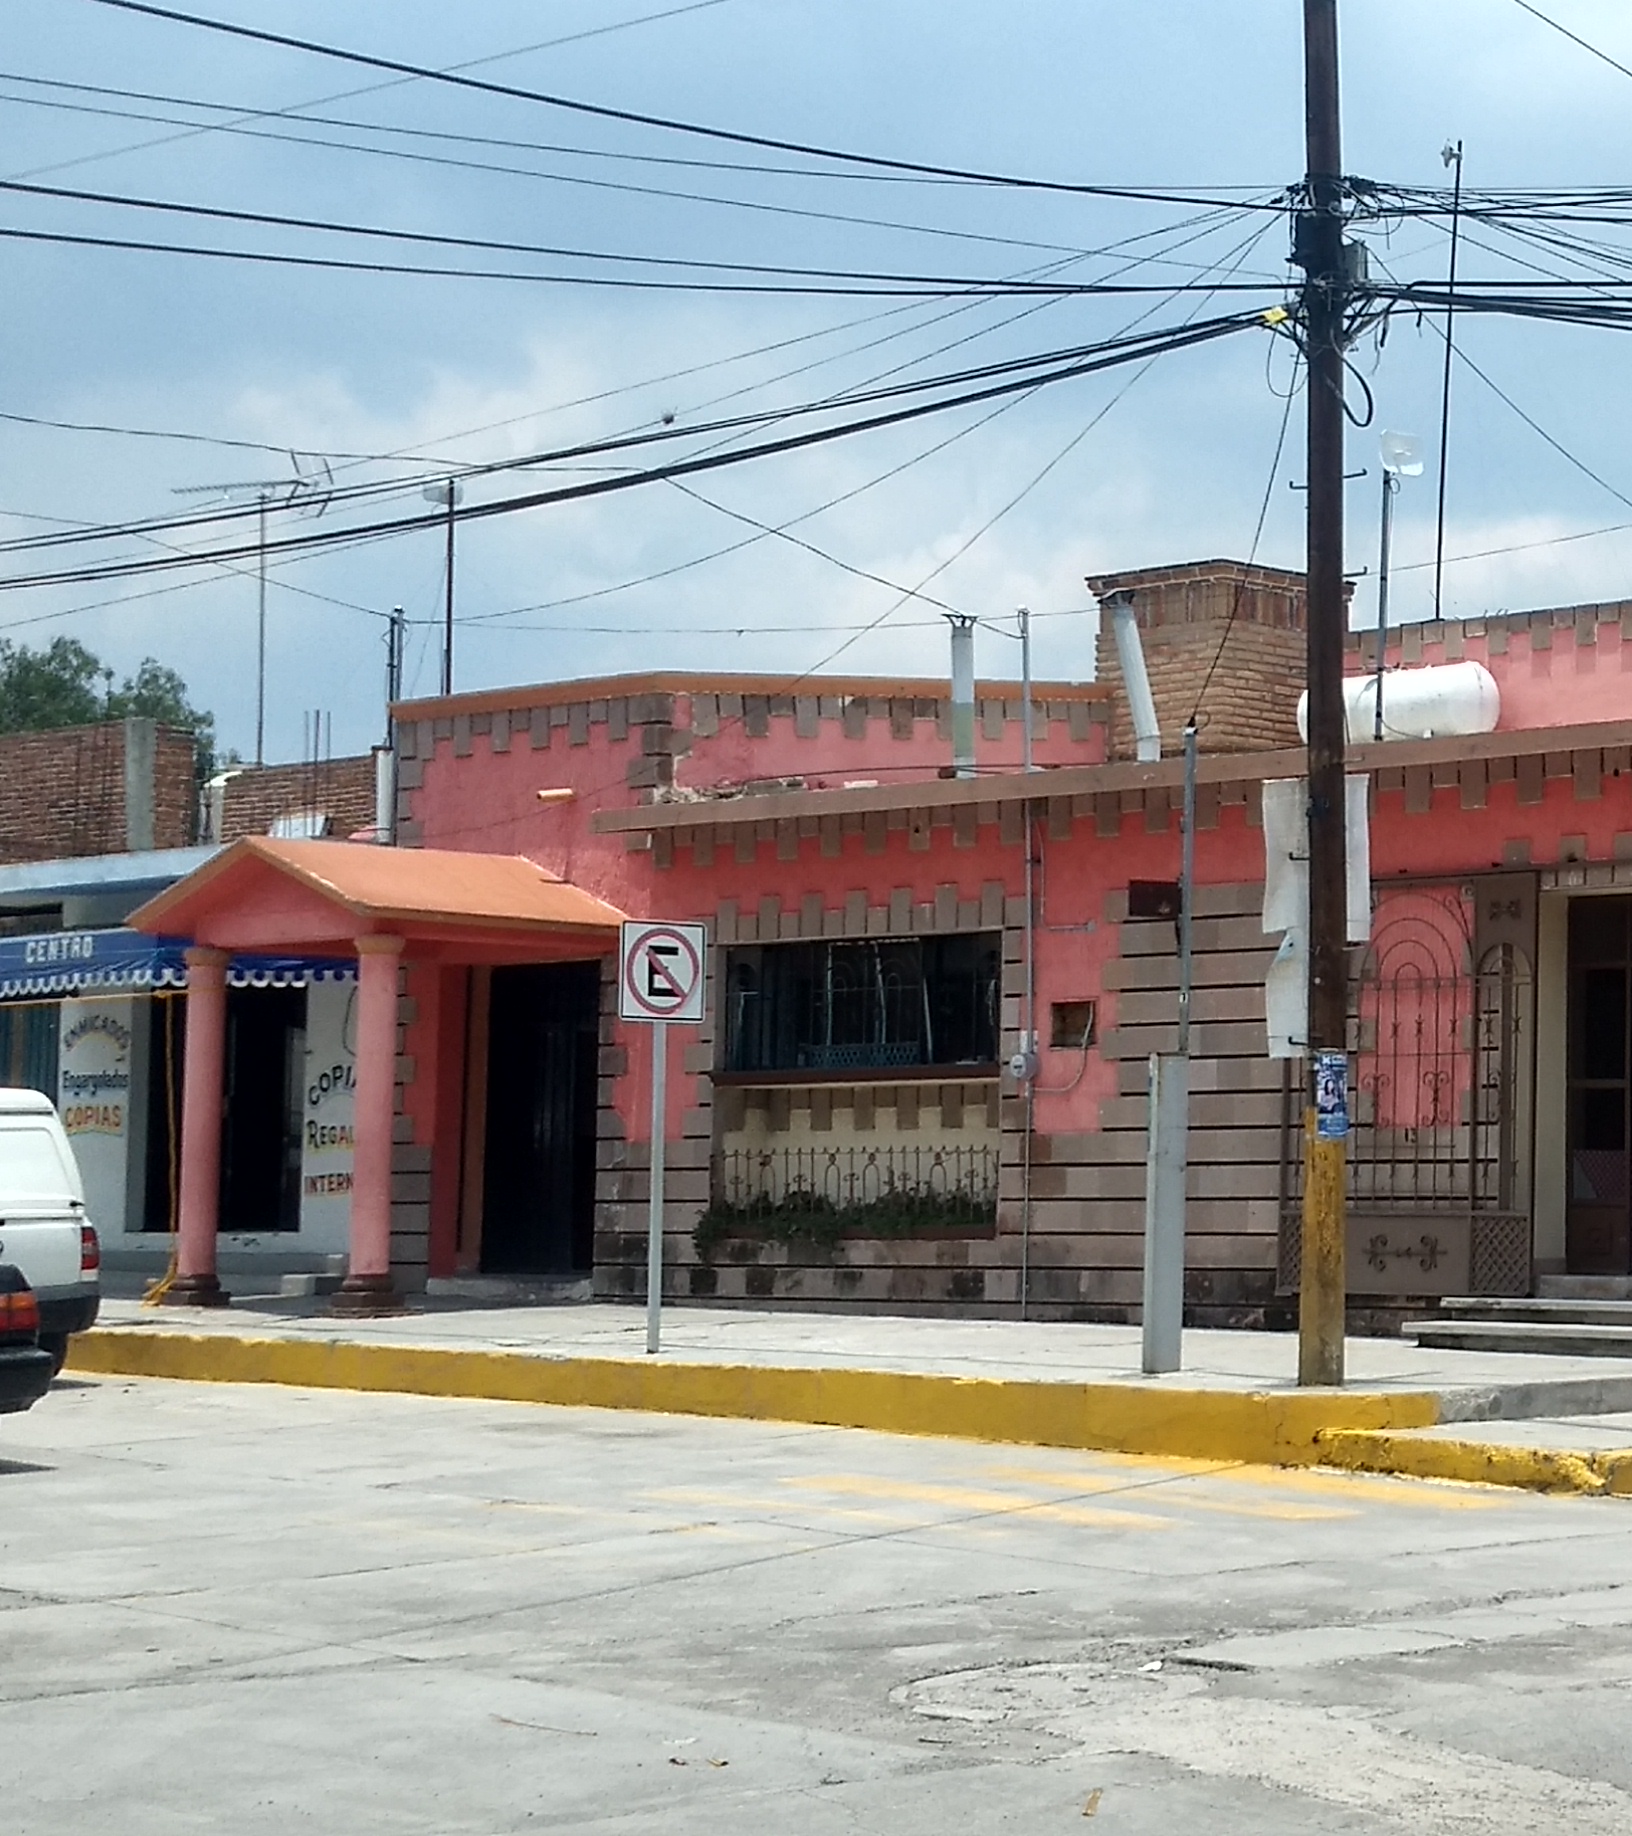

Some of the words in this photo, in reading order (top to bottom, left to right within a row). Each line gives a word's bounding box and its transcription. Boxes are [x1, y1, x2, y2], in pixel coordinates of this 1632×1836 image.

[26, 936, 93, 962] CENTRO
[308, 1064, 357, 1106] COPI
[66, 1105, 122, 1128] COPIAS
[306, 1119, 355, 1149] REGAL
[304, 1172, 354, 1193] INTERN
